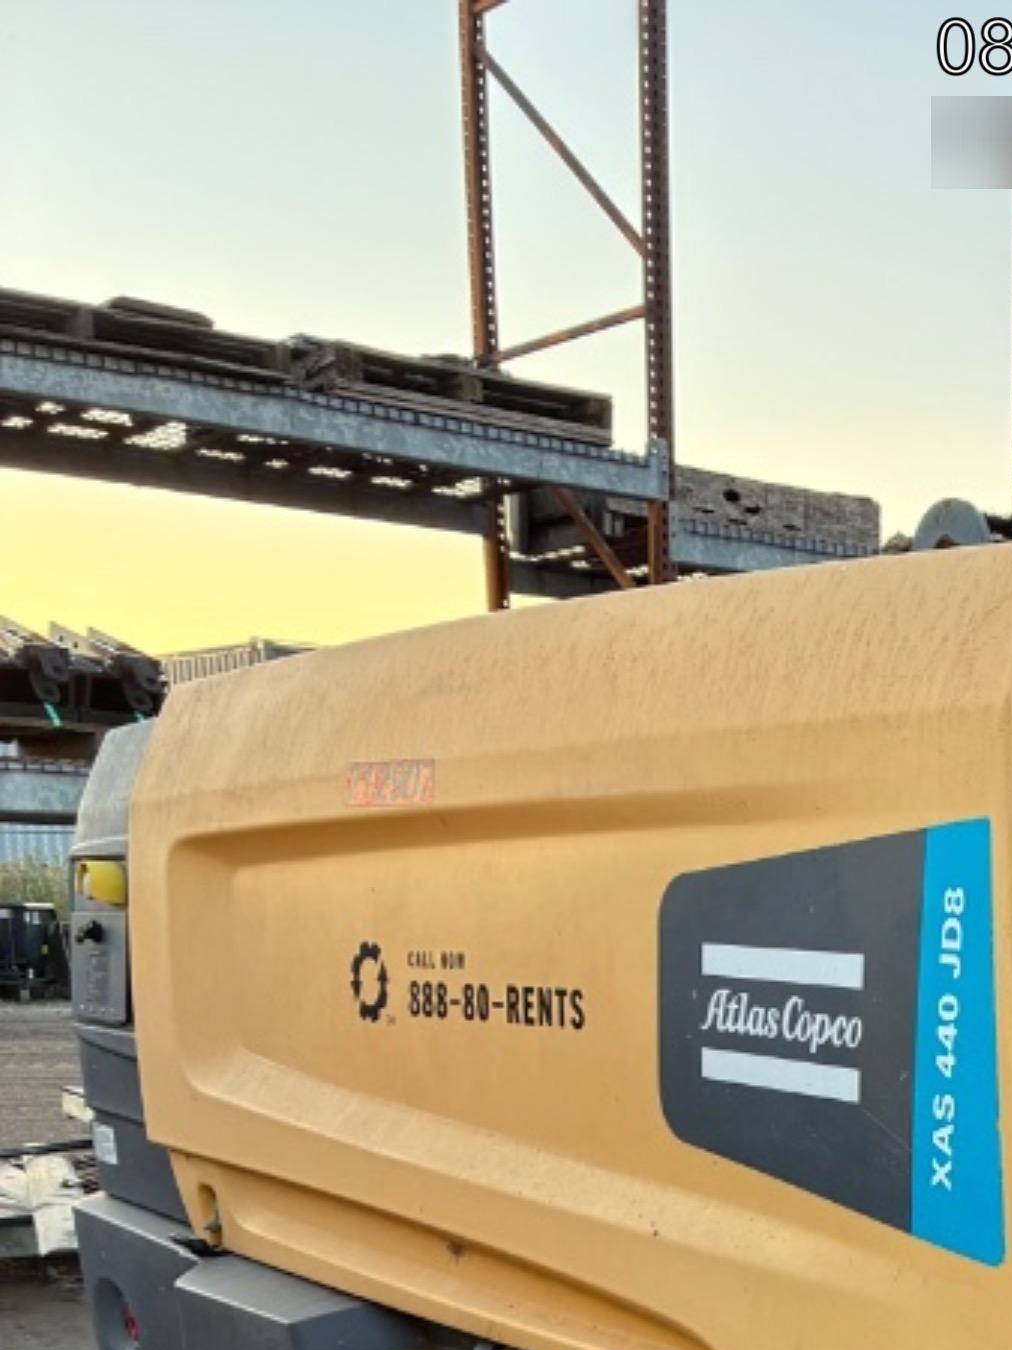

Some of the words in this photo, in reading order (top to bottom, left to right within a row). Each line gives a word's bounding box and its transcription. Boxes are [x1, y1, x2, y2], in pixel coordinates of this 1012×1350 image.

[407, 951, 436, 970] CALL
[440, 952, 466, 971] NOW
[938, 886, 966, 981] JD8
[408, 979, 586, 1031] 888-80-RENTS
[700, 988, 781, 1039] Atlas
[781, 994, 863, 1055] Copco
[934, 992, 960, 1079] 440
[929, 1092, 956, 1193] XAS
